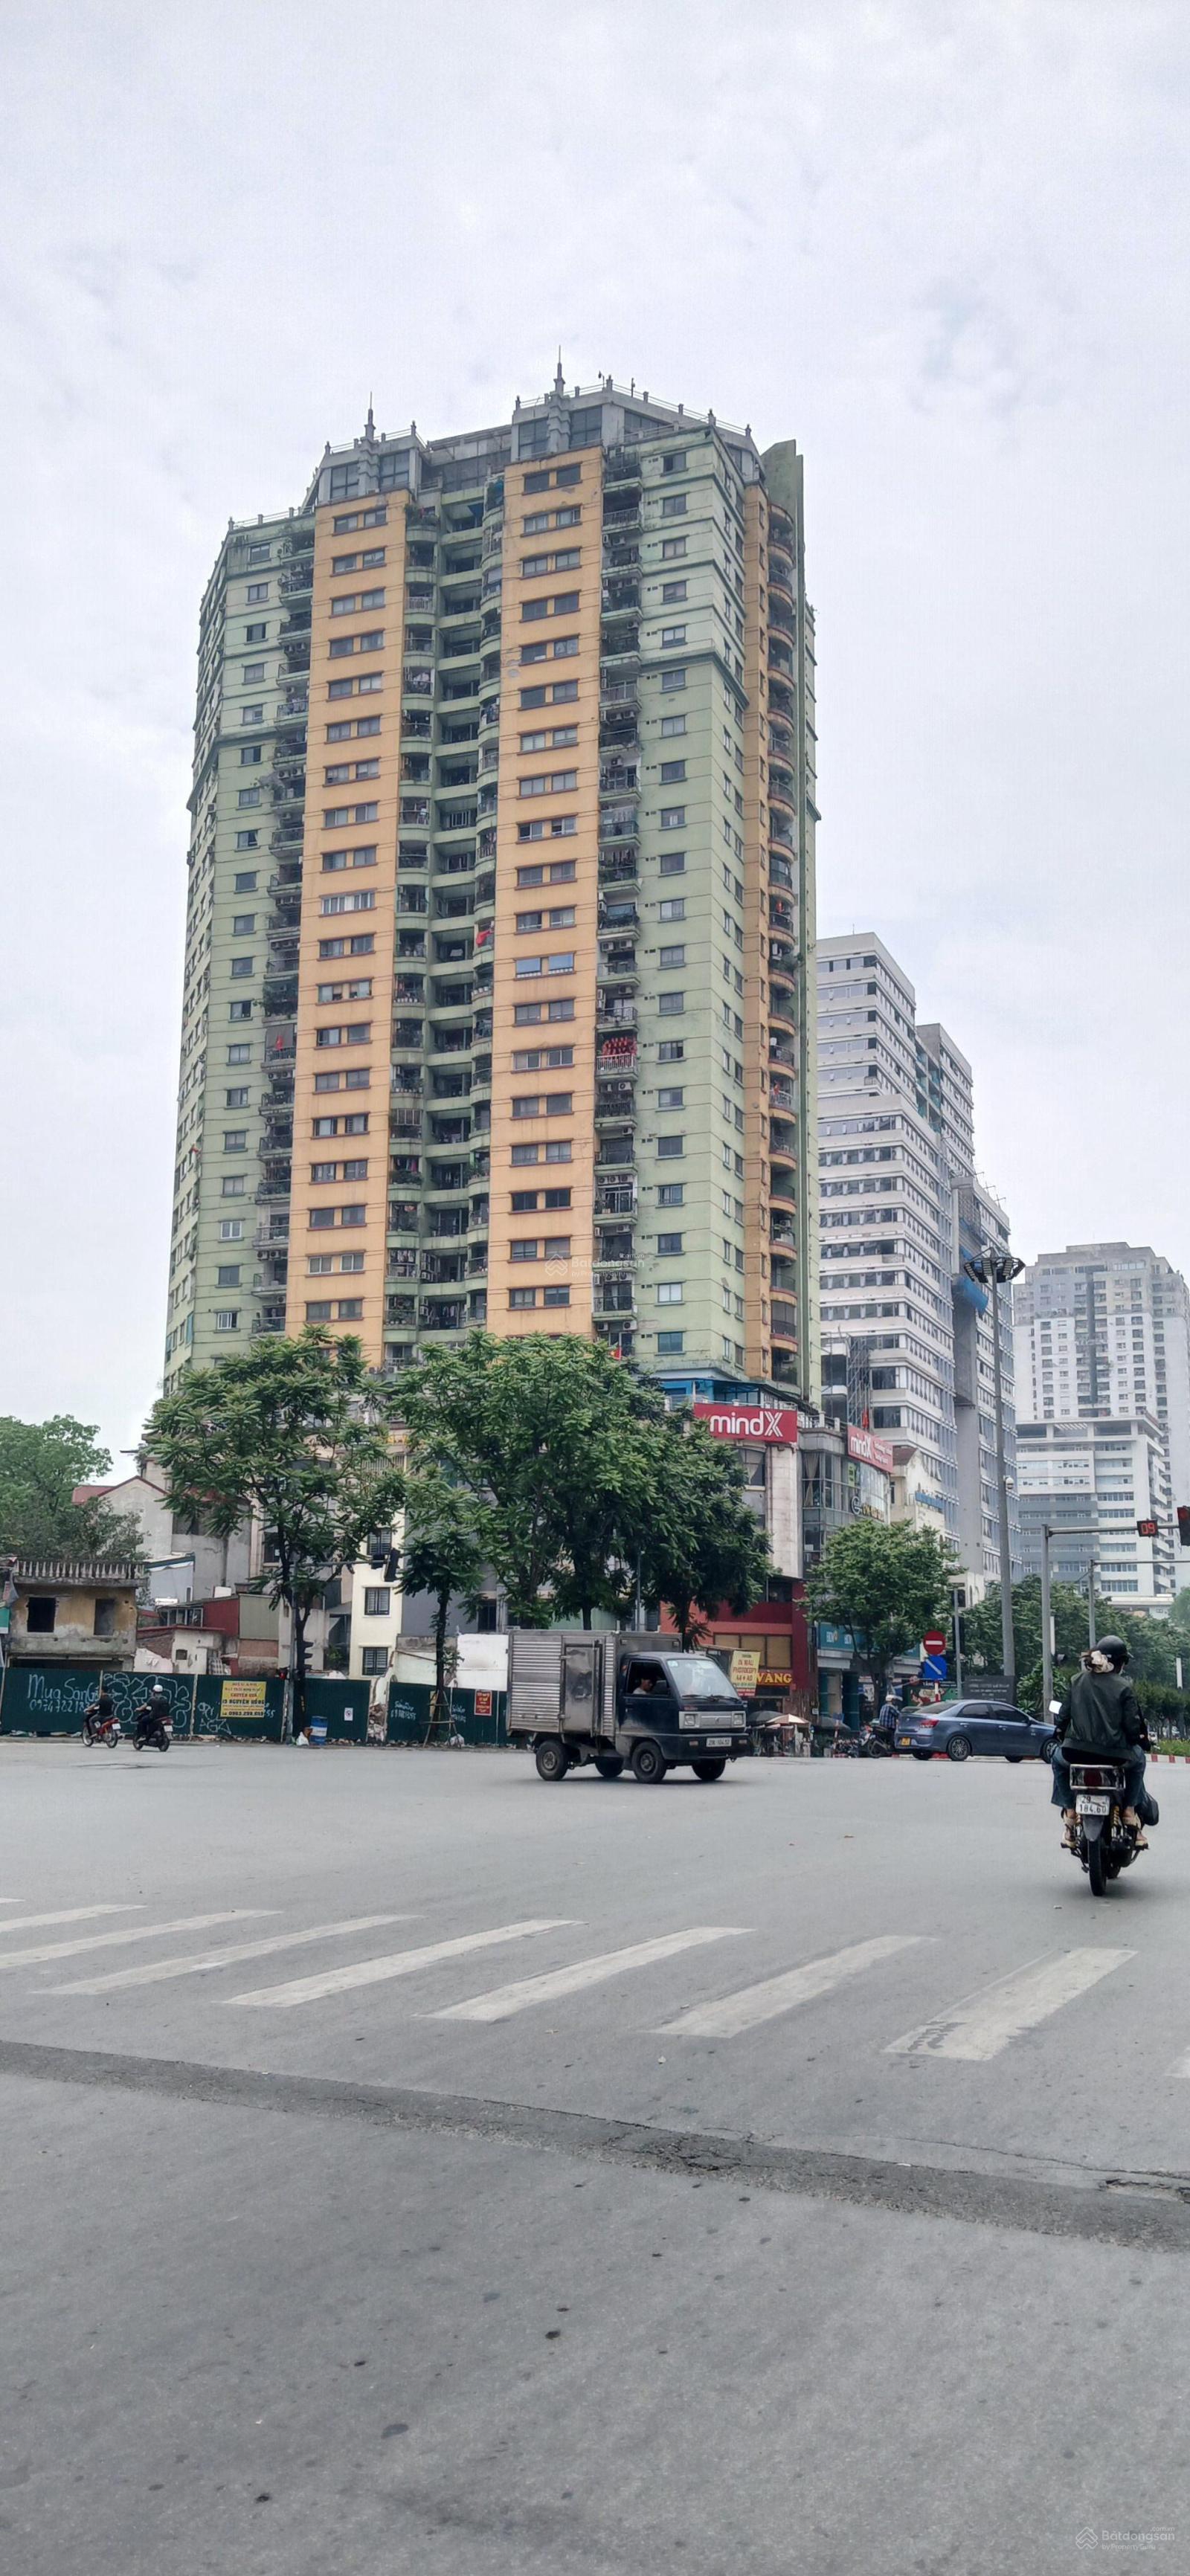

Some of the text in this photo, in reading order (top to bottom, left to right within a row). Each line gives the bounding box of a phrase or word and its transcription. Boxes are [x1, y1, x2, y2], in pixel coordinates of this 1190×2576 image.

[710, 1411, 783, 1437] mindX
[850, 1432, 872, 1460] mindX
[1142, 1522, 1155, 1534] 09
[27, 1674, 61, 1700] Mua
[756, 1670, 792, 1684] VÀNG
[1080, 1803, 1107, 1813] 184.60
